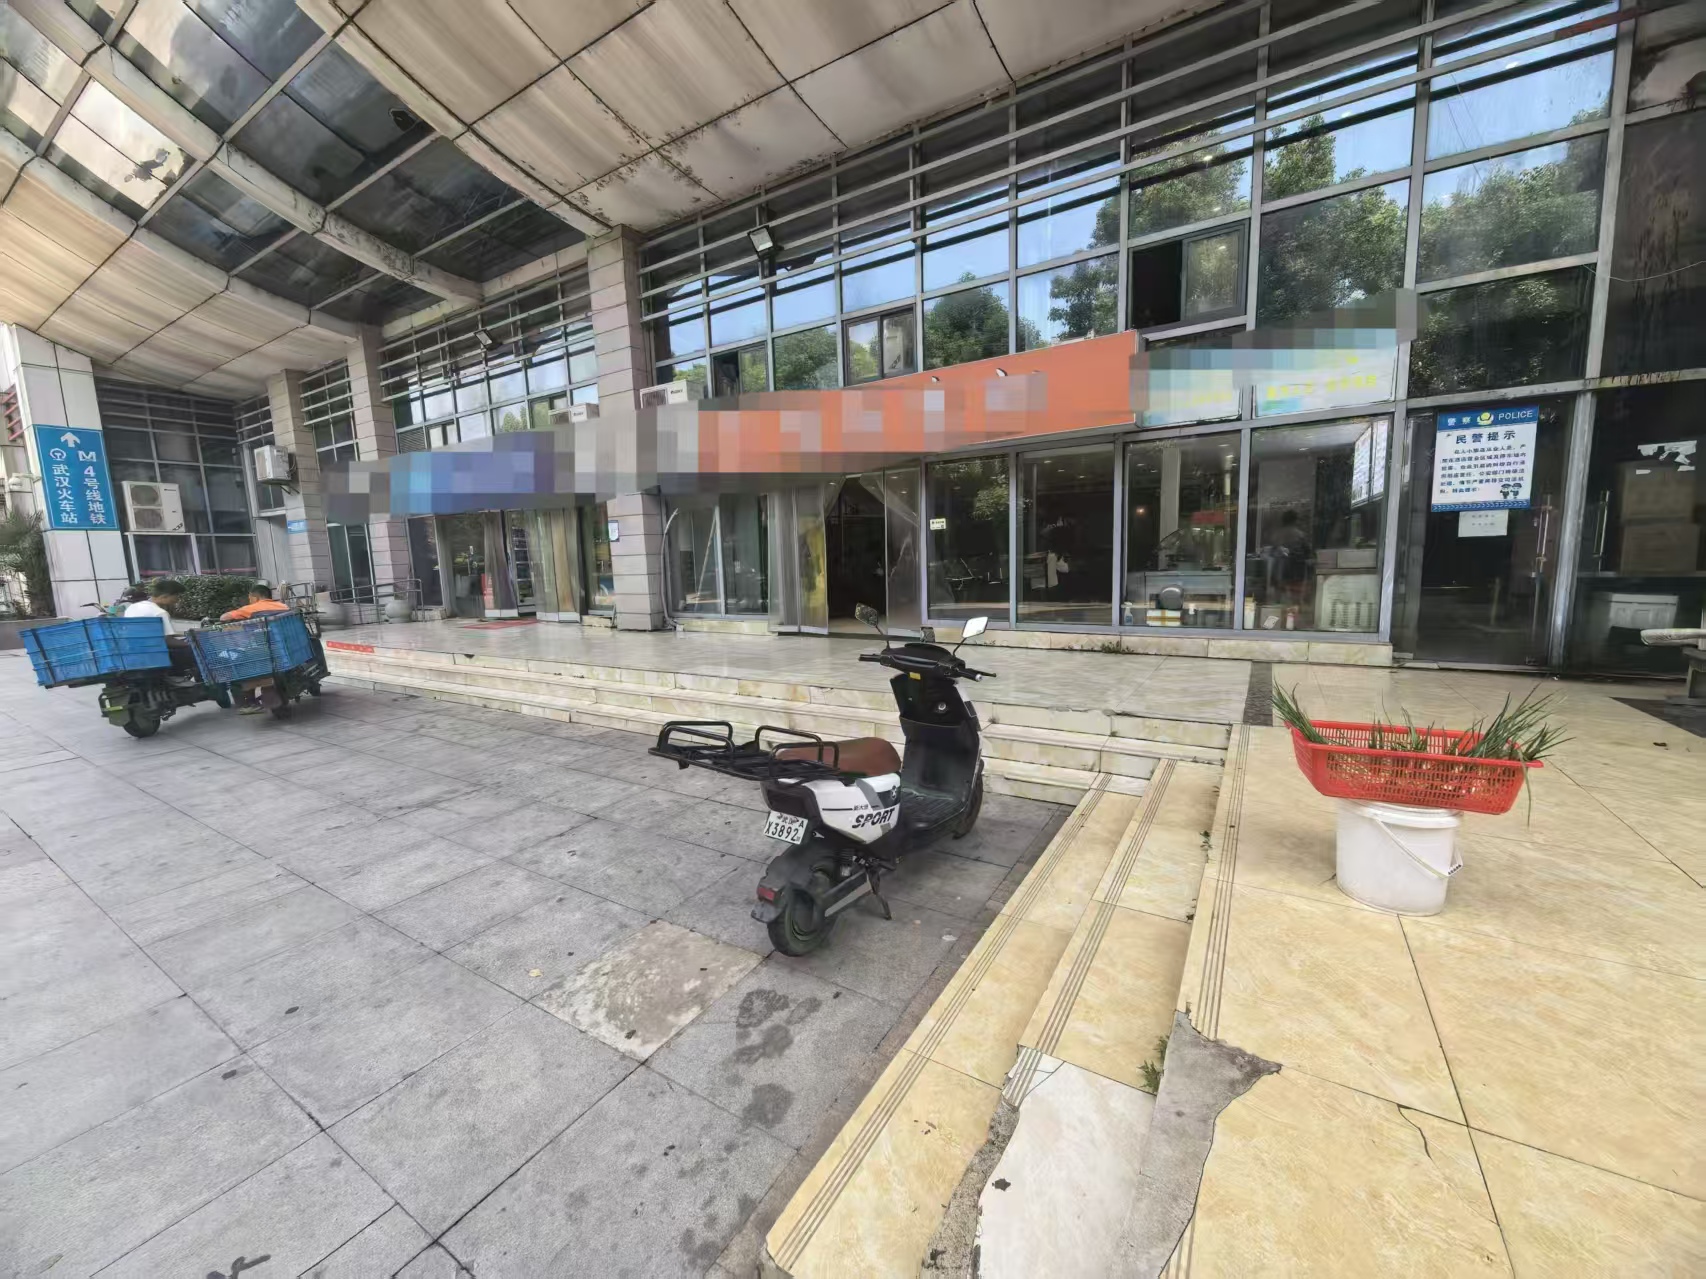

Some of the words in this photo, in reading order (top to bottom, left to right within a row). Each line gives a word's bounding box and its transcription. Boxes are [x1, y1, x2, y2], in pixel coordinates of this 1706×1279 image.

[1447, 416, 1471, 426] 警察
[1498, 410, 1533, 421] POLICE
[1455, 430, 1516, 444] 民警提示
[52, 464, 78, 524] 武汉火车站
[83, 465, 107, 525] 4号线地铁
[851, 808, 896, 829] SPORT
